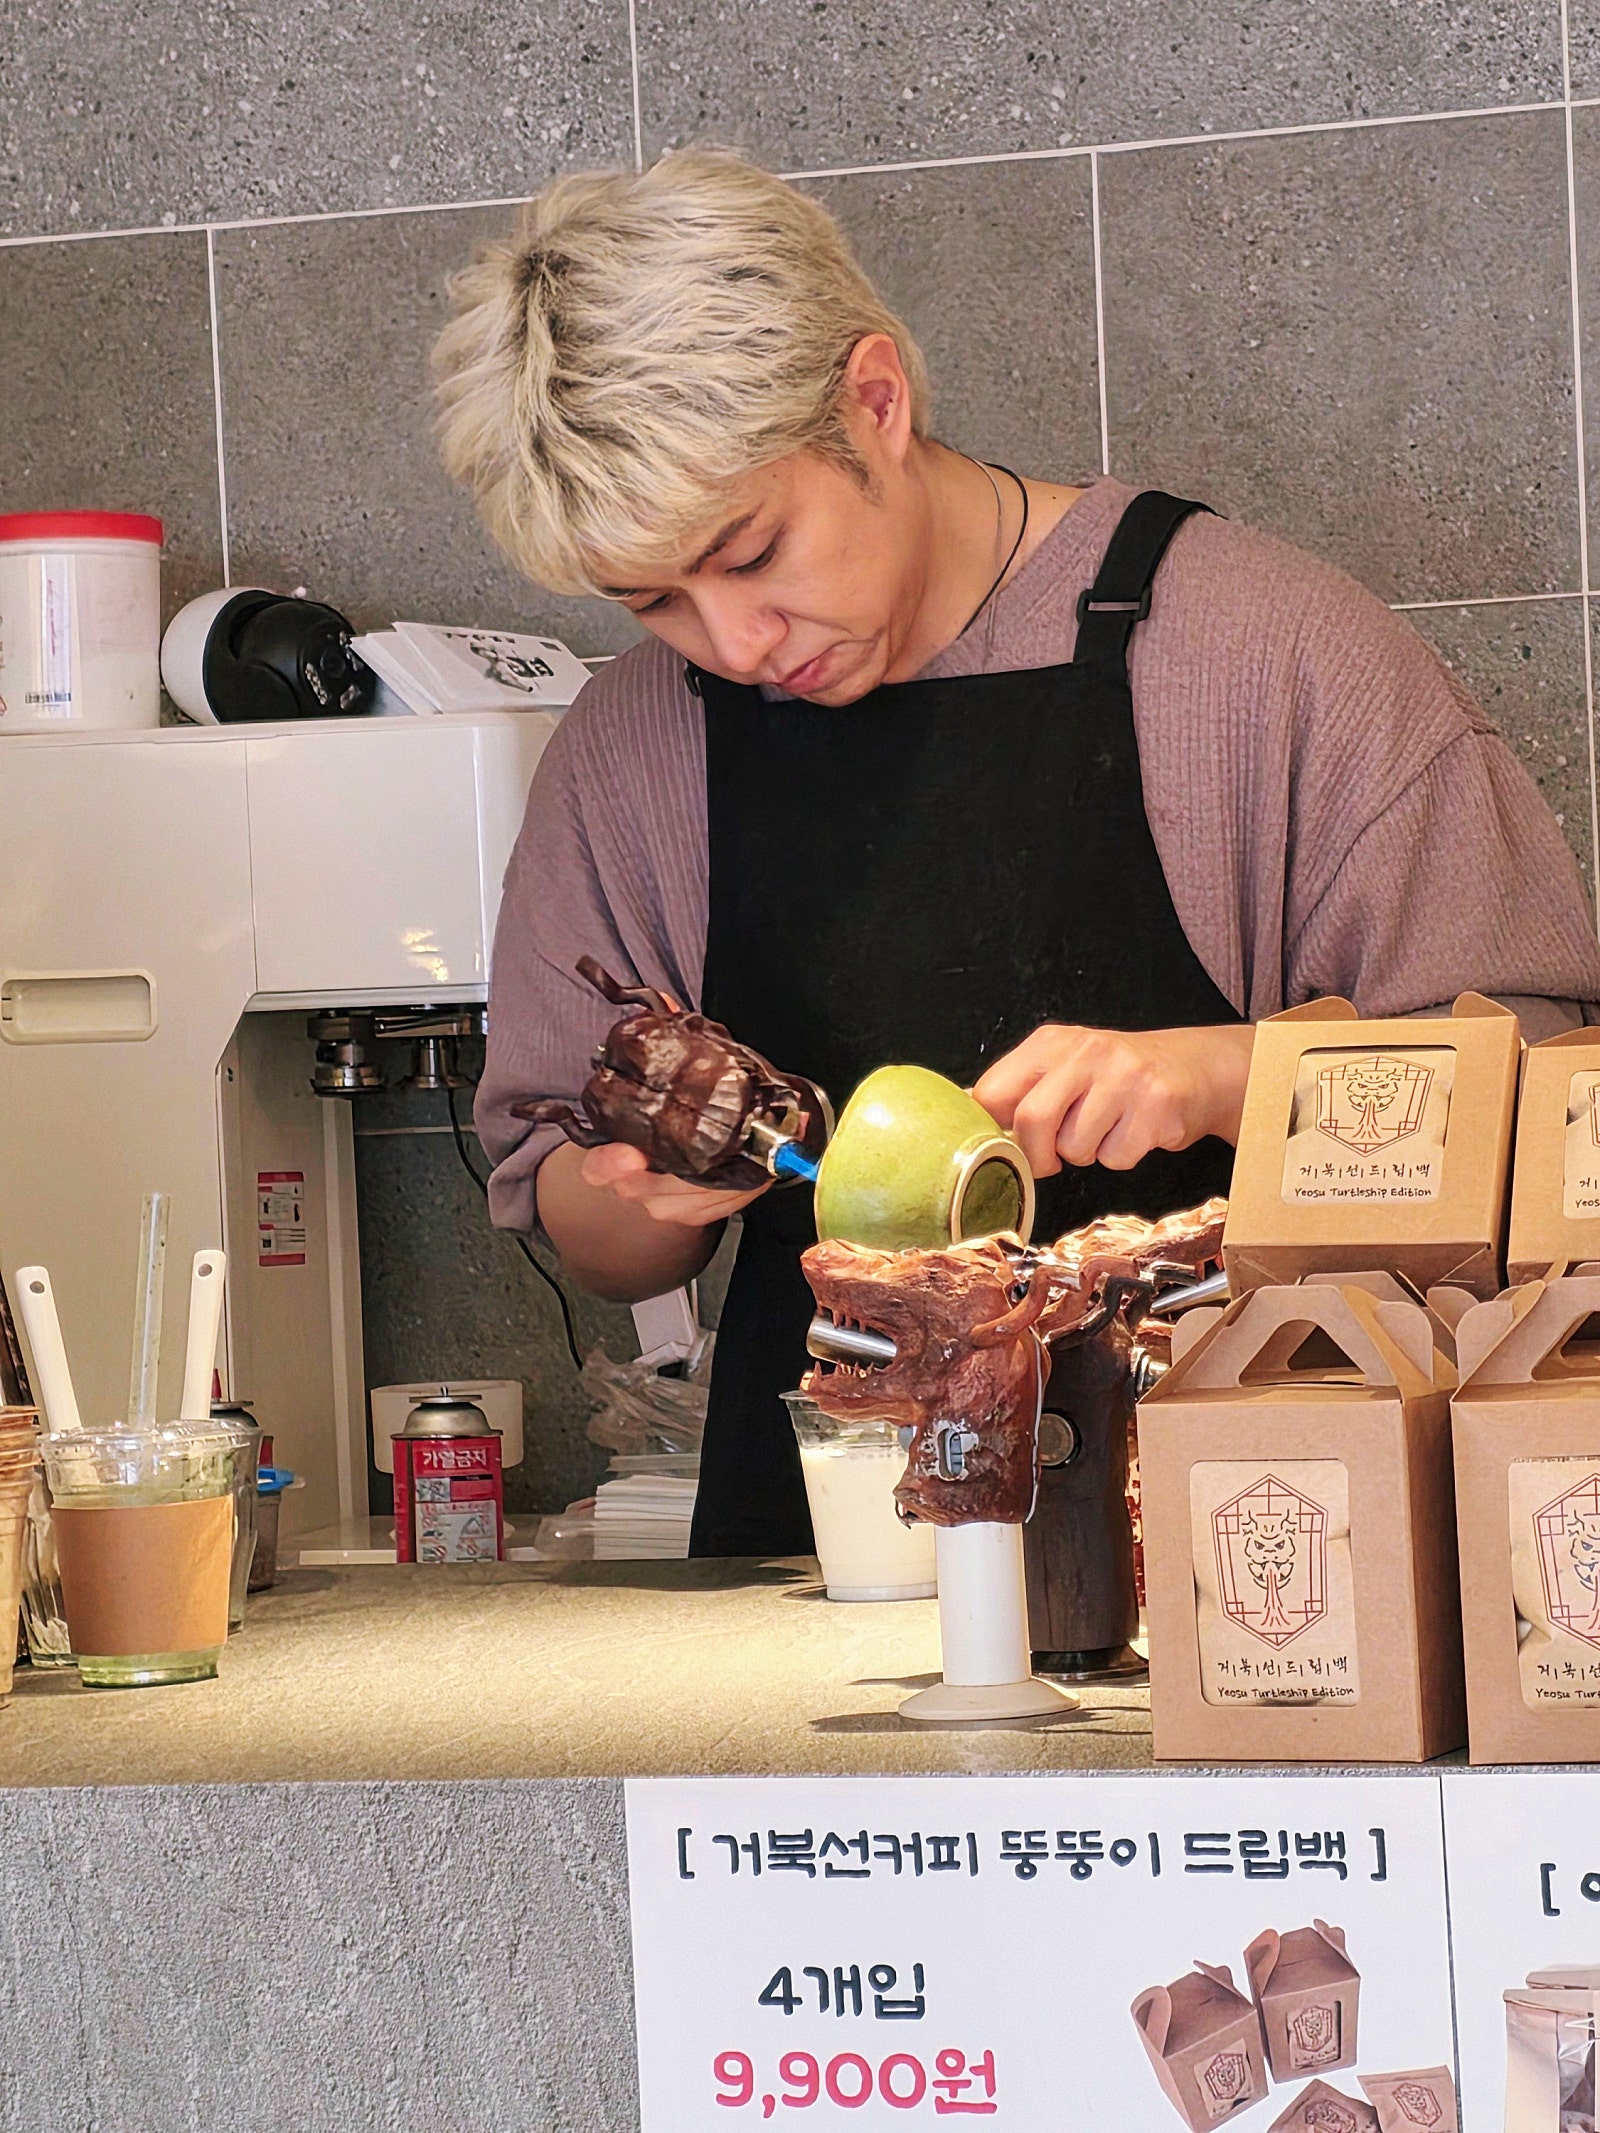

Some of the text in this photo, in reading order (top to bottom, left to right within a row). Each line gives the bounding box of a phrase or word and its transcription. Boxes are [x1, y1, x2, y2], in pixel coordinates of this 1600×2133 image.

[1294, 1187, 1432, 1198] Yeosu Turtleship Edition
[1217, 1687, 1355, 1699] Yeosu Turtleship Edition
[1535, 1688, 1570, 1700] Yeosu
[711, 1828, 978, 1879] 거북선커피
[999, 1829, 1161, 1881] 뚱뚱이
[1183, 1829, 1348, 1881] 드립백
[757, 1962, 926, 2020] 4개입
[713, 2048, 998, 2119] 9,900원
